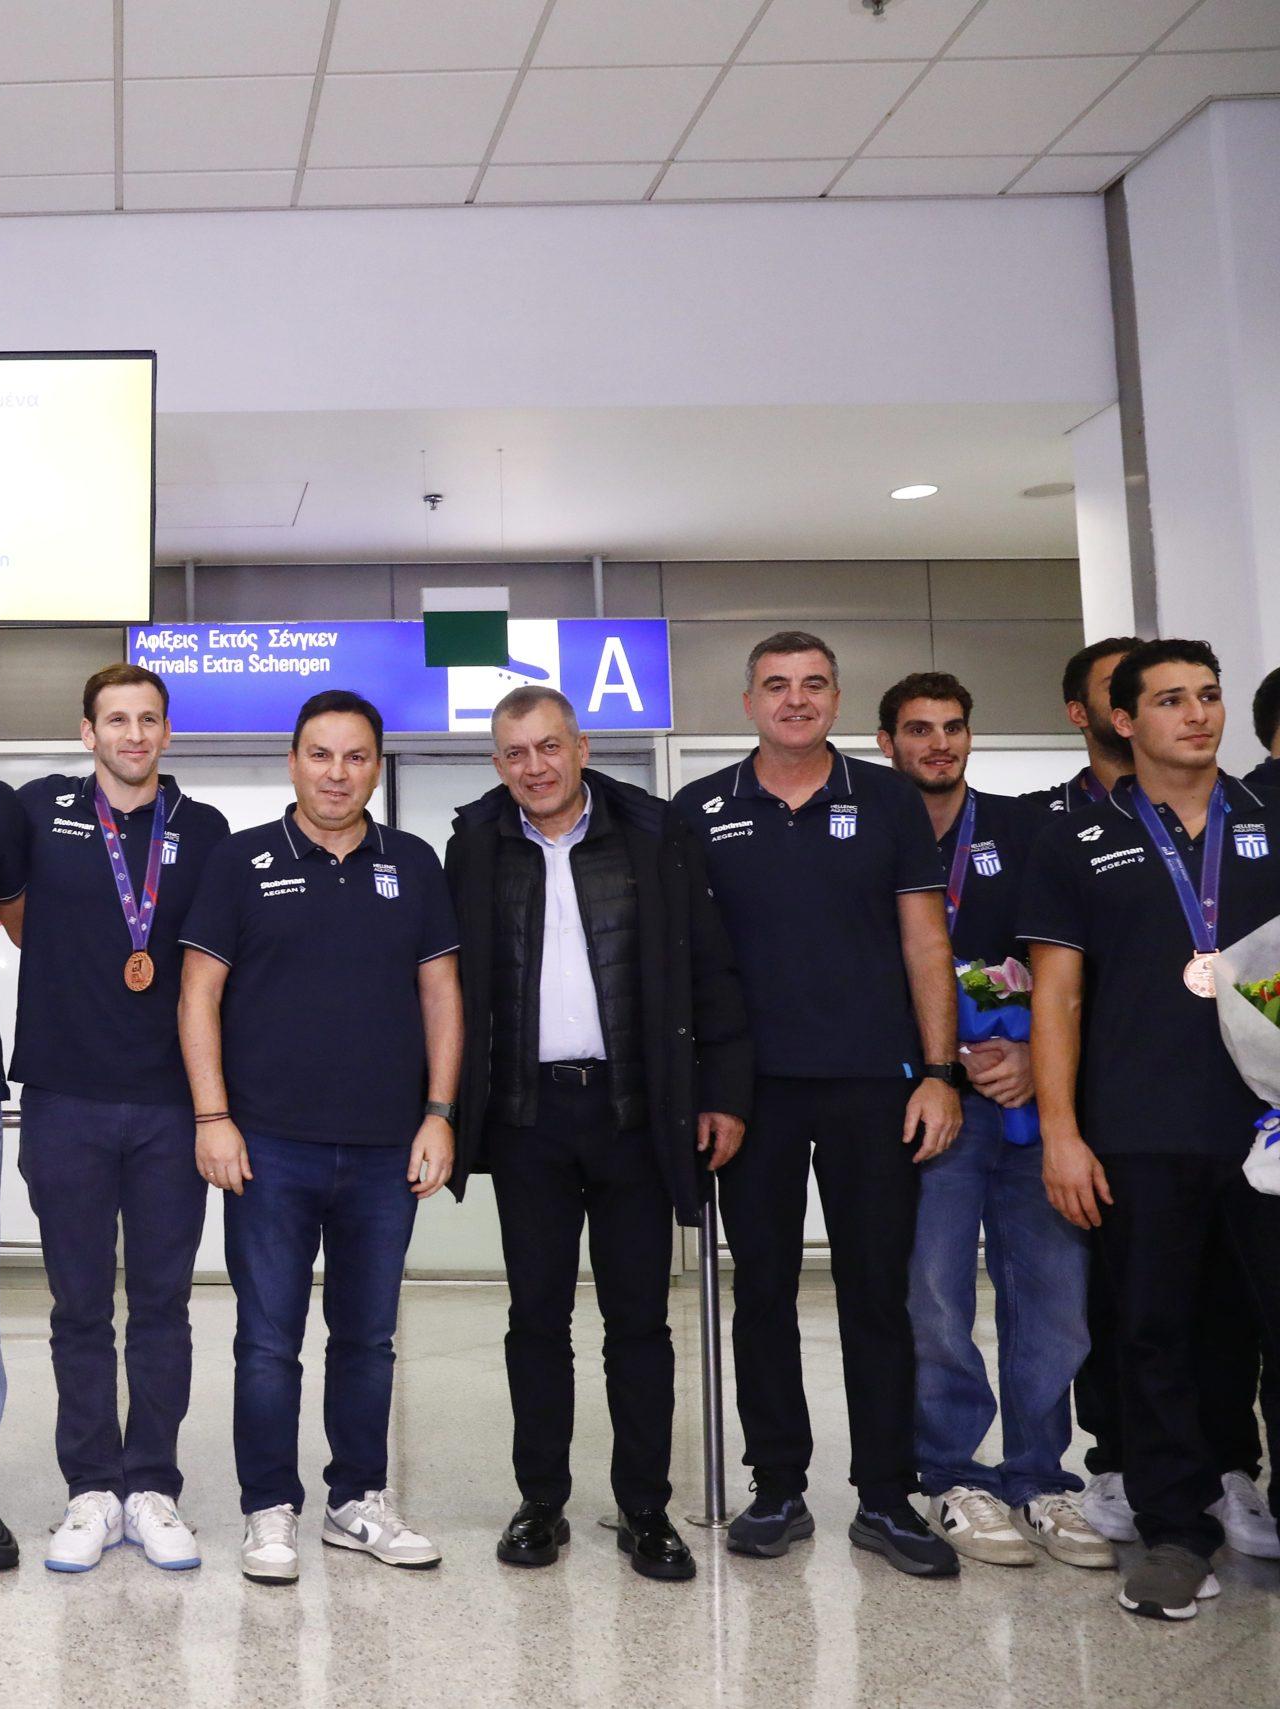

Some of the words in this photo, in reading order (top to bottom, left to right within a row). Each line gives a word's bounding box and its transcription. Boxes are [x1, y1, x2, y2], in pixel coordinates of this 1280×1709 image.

[135, 630, 199, 652] Αφίξεις
[208, 629, 258, 652] Εκτός
[268, 628, 338, 650] Σένγκεν
[136, 656, 198, 674] Arrivals
[202, 655, 244, 674] Extra
[248, 654, 330, 676] Schengen
[587, 636, 644, 712] A
[702, 796, 723, 810] arena
[52, 827, 84, 837] AEGEAN
[712, 830, 746, 842] AEGEAN
[1078, 824, 1102, 839] arena
[1096, 858, 1136, 874] AEGEAN
[263, 887, 298, 897] AEGEAN
